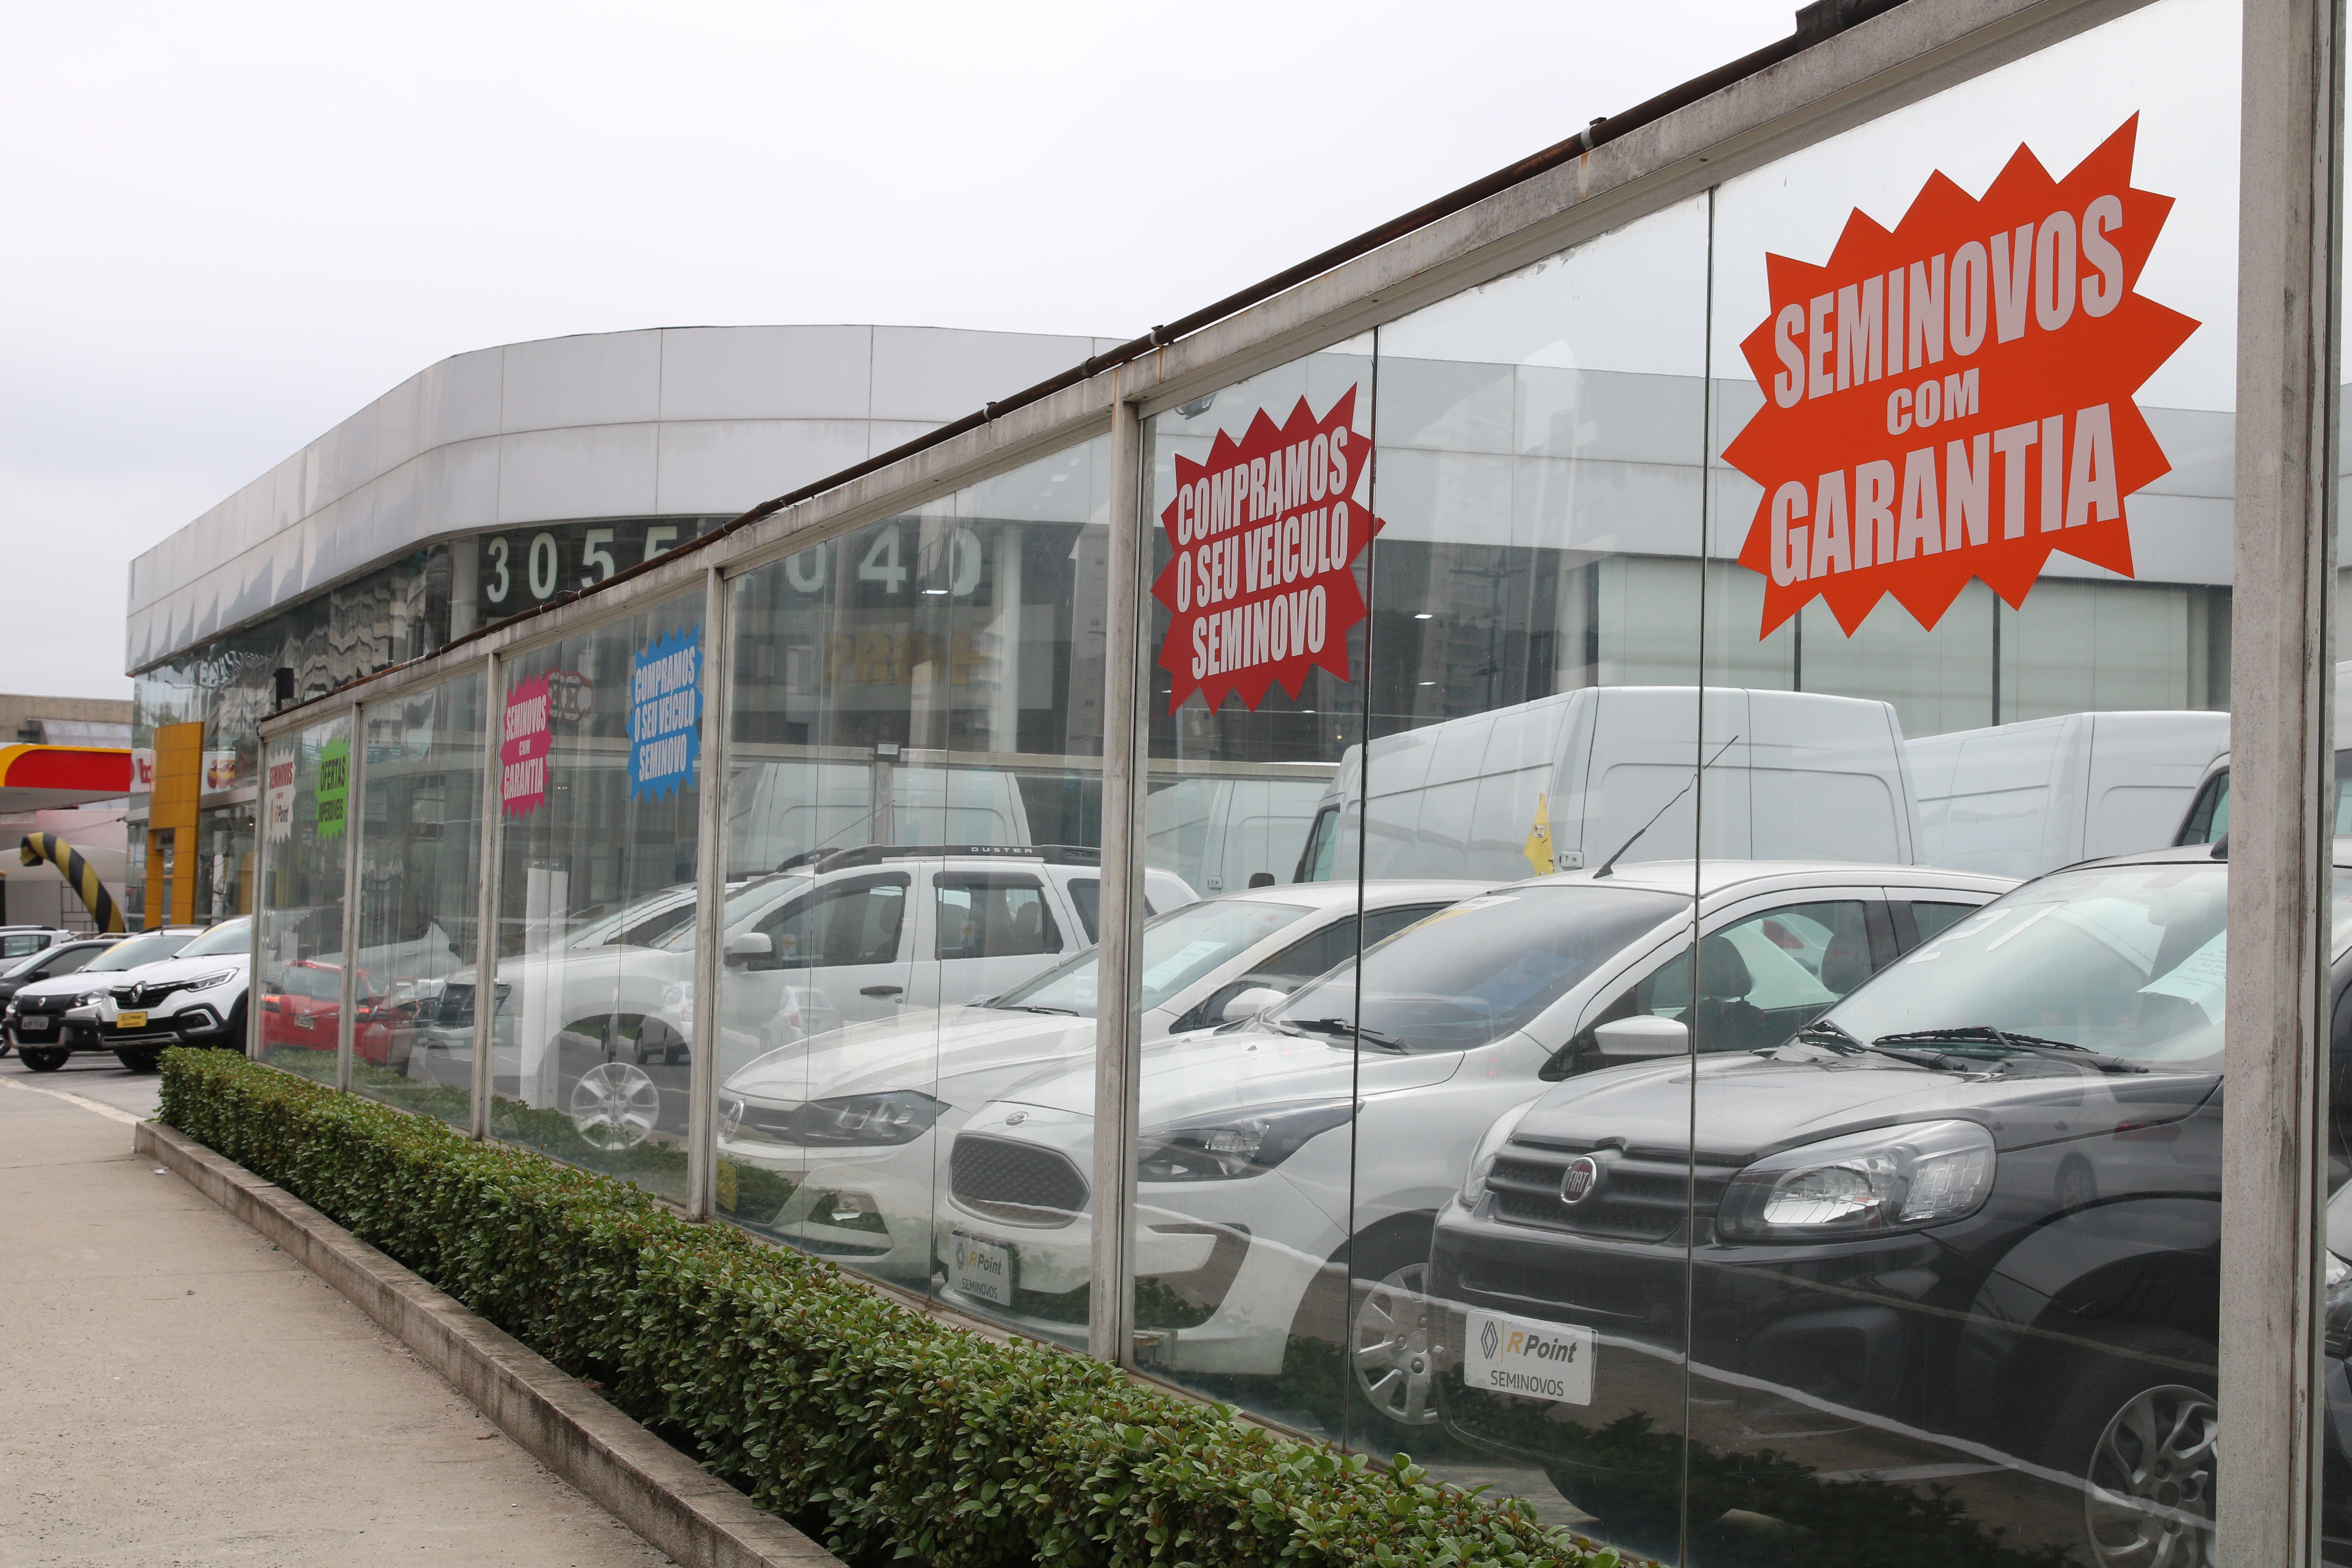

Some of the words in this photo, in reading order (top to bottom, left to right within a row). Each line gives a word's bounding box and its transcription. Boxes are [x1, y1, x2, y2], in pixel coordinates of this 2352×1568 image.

[1773, 195, 2123, 408] SEMINOVOS
[1887, 367, 1979, 435] COM
[1178, 426, 1348, 546] COMPRAMOS
[1770, 403, 2120, 587] GARANTIA
[1177, 551, 1191, 613] O
[1197, 535, 1239, 607] SEU
[1245, 501, 1348, 594] VEÍCULO
[1192, 585, 1327, 679] SEMINOVO
[635, 646, 695, 704] COMPRAMOS
[506, 695, 546, 742] SEMINOVOS
[635, 707, 639, 742] O
[642, 701, 658, 737] SEU
[659, 688, 695, 735] VEÍCULO
[519, 739, 530, 756] COM
[639, 734, 686, 782] SEMINOVO
[269, 761, 293, 789] SEMINOVOS
[320, 756, 345, 792] OFERTAS
[504, 757, 543, 800] GARANTIA
[1567, 1171, 1590, 1192] FIAT
[962, 1278, 997, 1299] SEMINOVOS
[1491, 1370, 1563, 1396] SEMINOVOS
